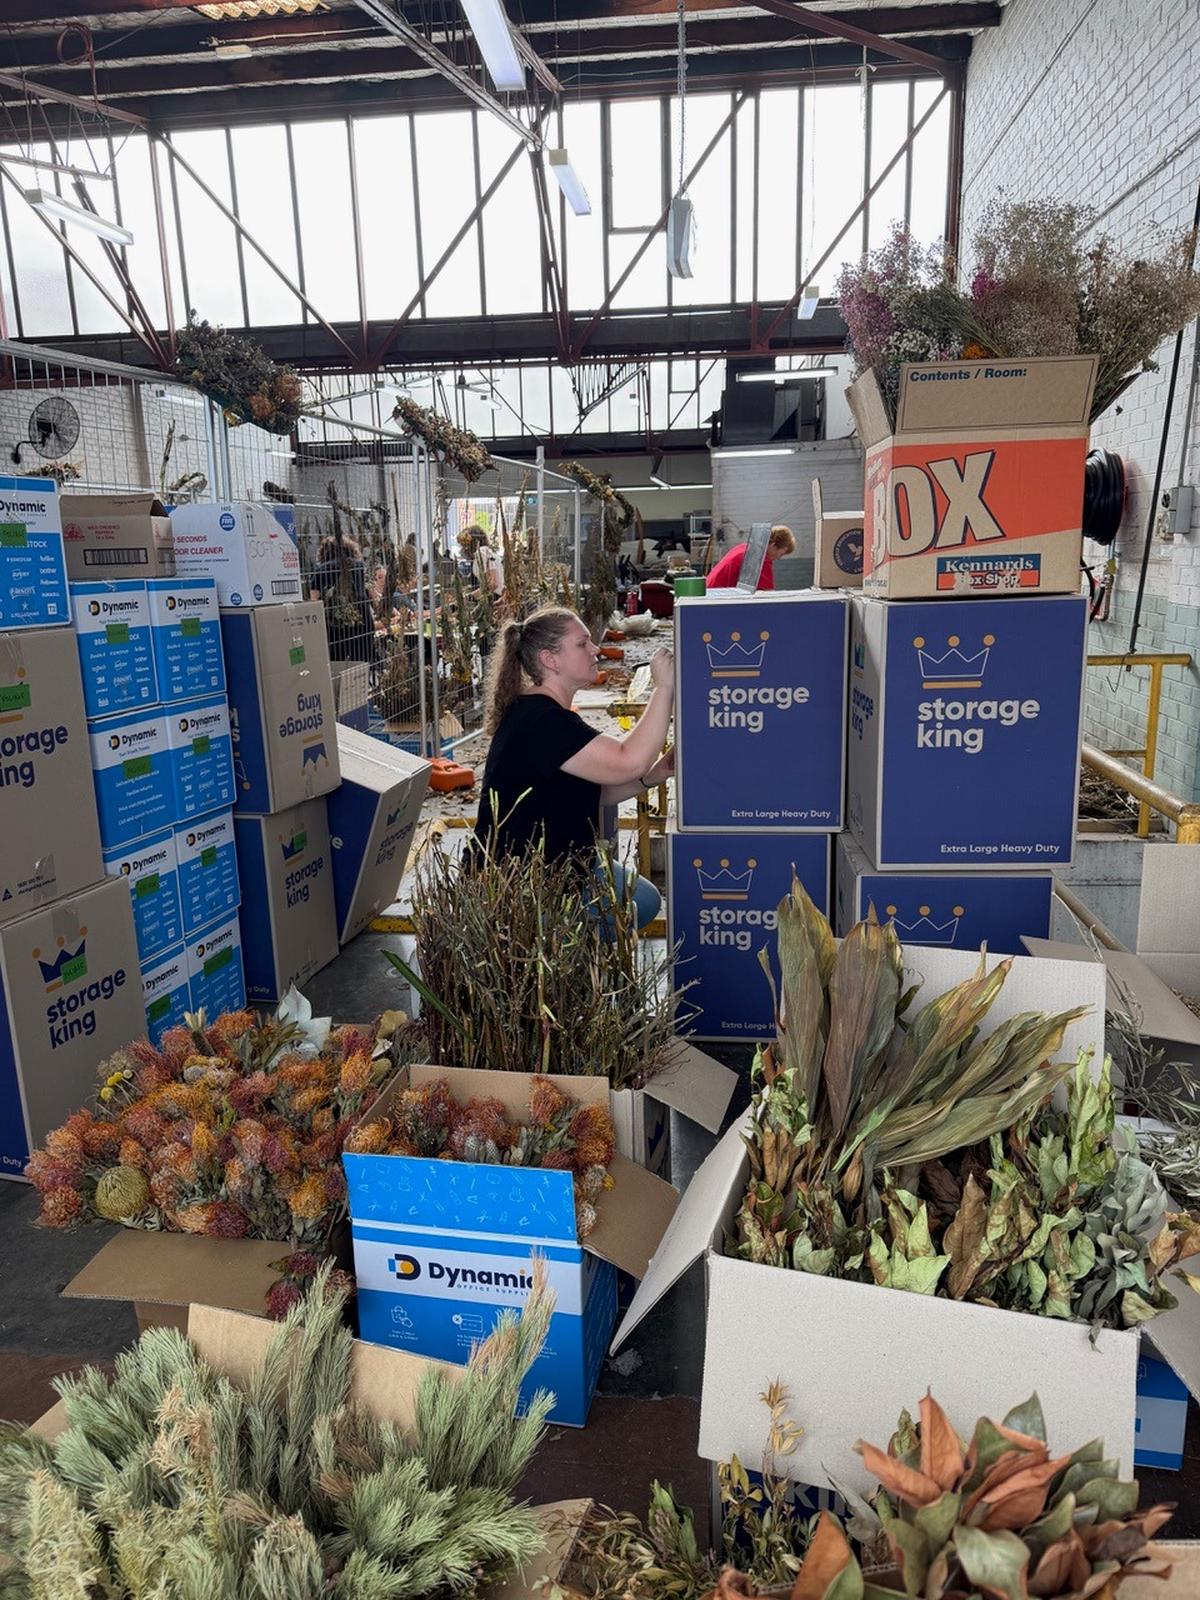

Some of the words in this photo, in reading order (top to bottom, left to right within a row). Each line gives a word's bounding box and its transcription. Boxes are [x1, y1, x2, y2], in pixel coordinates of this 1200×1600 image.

[910, 368, 971, 382] Contents
[984, 367, 1028, 379] Room:
[176, 535, 208, 544] SECONDS
[190, 546, 224, 555] CLEANER
[944, 556, 1034, 573] Kennards
[102, 600, 139, 616] Dynamic
[177, 596, 210, 611] Dynamic
[297, 693, 322, 713] king
[708, 685, 810, 710] storage
[190, 712, 221, 730] Dynamic
[709, 706, 764, 733] king
[917, 697, 1041, 727] storage
[122, 727, 157, 747] Dynamic
[279, 714, 323, 738] storage
[0, 725, 68, 757] orage
[917, 723, 984, 754] king
[0, 761, 35, 788] ing
[731, 810, 753, 818] Extra
[755, 810, 780, 819] Large
[781, 810, 808, 819] Heavy
[810, 810, 831, 819] Duty
[197, 822, 226, 842] Dynamic
[379, 821, 414, 851] storage
[375, 845, 396, 867] king
[940, 844, 967, 853] Extra
[969, 844, 999, 855] Large
[1000, 844, 1033, 854] Heavy
[1035, 843, 1060, 853] Duty
[133, 849, 168, 872] Dynamic
[285, 856, 325, 890] storage
[286, 882, 310, 909] king
[699, 906, 779, 930] storag
[205, 929, 233, 951] Dynamic
[699, 926, 751, 951] king
[145, 964, 179, 990] Dynamic
[46, 967, 127, 1025] storage
[49, 1007, 97, 1050] king
[721, 1021, 743, 1029] Extra
[744, 1021, 768, 1031] Large
[456, 1282, 490, 1293] OFFICE
